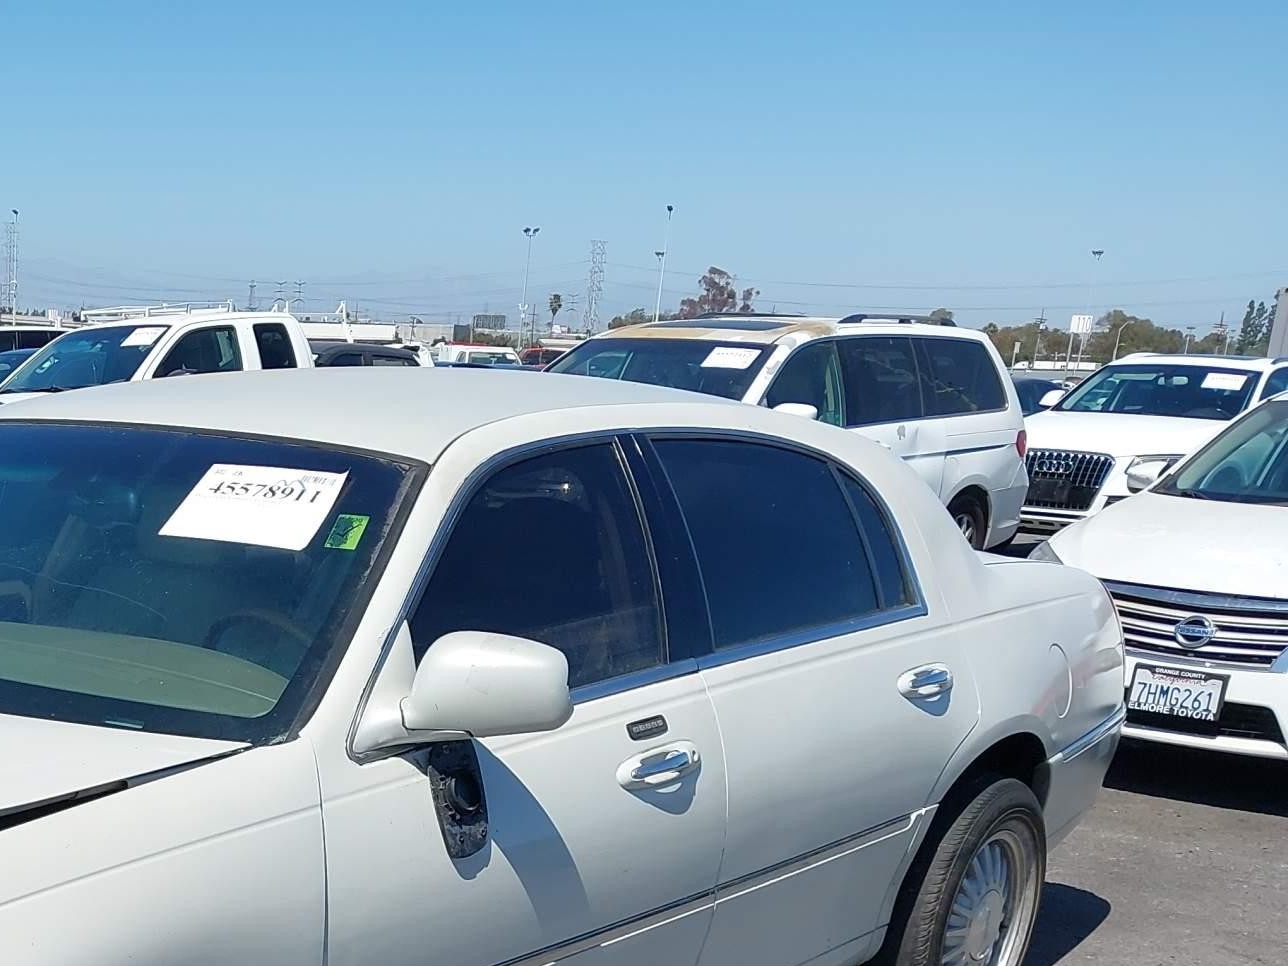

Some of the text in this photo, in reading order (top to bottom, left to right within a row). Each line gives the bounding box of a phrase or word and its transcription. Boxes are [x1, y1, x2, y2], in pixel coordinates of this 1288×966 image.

[208, 481, 321, 503] 45578911
[1155, 667, 1206, 679] ORANGE COUNTY
[1137, 681, 1213, 711] 7HMG261
[1128, 701, 1215, 721] ELMORE TOYOTA
